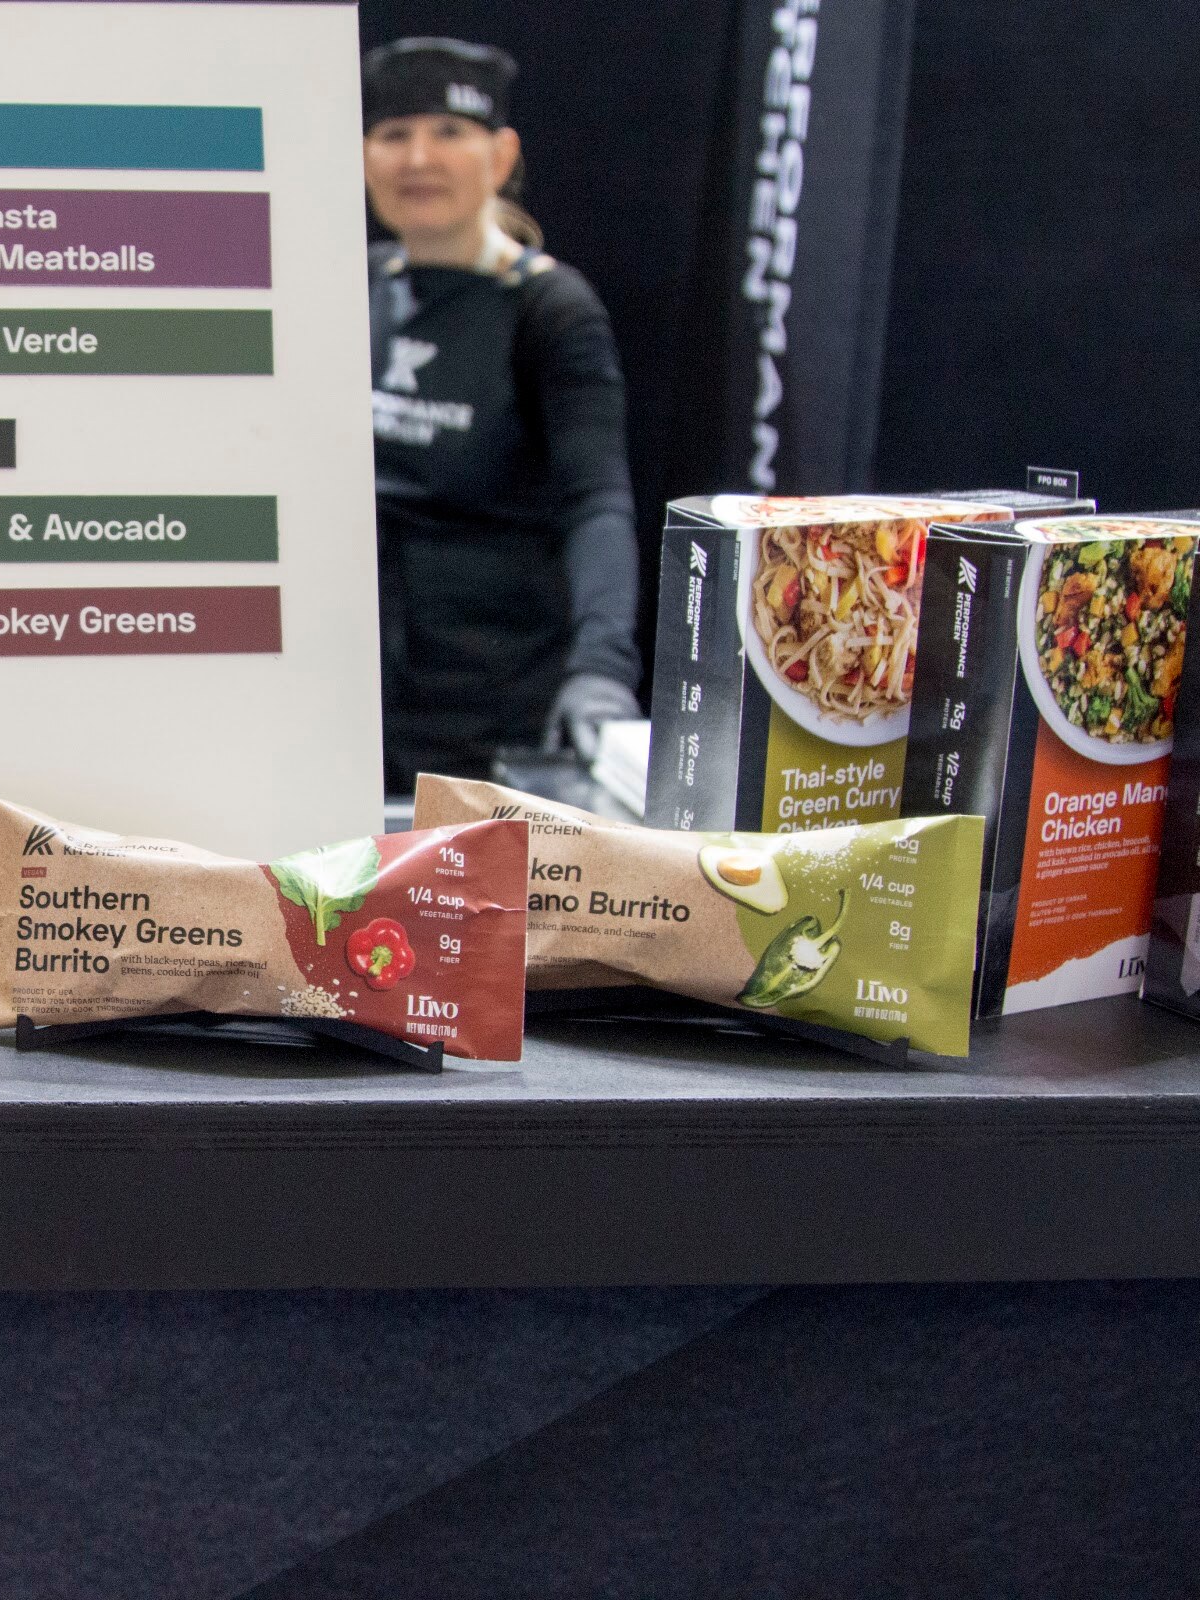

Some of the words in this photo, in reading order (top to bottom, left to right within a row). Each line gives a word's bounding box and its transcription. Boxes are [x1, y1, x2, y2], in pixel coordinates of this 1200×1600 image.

[2, 327, 99, 355] Verde
[1038, 475, 1052, 486] FPO
[1053, 476, 1068, 487] BOX
[7, 513, 33, 543] &
[43, 513, 187, 543] Avocado
[686, 576, 696, 624] KITCHEN
[79, 606, 196, 636] Greens
[691, 577, 703, 661] PERFORMANCE
[953, 592, 964, 640] KITCHEN
[957, 593, 972, 678] PERFORMANCE
[688, 683, 702, 713] 15g
[950, 701, 966, 730] 13g
[688, 733, 700, 758] 1/2
[685, 759, 695, 787] cup
[781, 759, 885, 791] Thai-style
[947, 751, 960, 777] 1/2
[779, 792, 840, 819] Green
[846, 786, 901, 810] Curry
[942, 777, 954, 806] cup
[1044, 789, 1117, 816] Orange
[1122, 781, 1168, 808] Man
[1041, 815, 1122, 843] Chicken
[439, 847, 465, 867] 11g
[435, 867, 465, 877] PROTEIN
[858, 872, 884, 891] 1/4
[888, 881, 915, 897] cup
[19, 884, 150, 911] Southern
[407, 886, 433, 905] 1/4
[437, 893, 465, 909] cup
[589, 890, 690, 922] Burrito
[419, 910, 464, 920] VEGETABLES
[16, 916, 127, 948] Smokey
[136, 918, 243, 947] Greens
[439, 934, 461, 954] 9g
[561, 924, 601, 935] avocado,
[604, 927, 622, 936] and
[624, 929, 657, 939] cheese
[889, 921, 911, 941] 8g
[15, 947, 110, 973] Burrito
[120, 955, 141, 964] with
[144, 955, 195, 967] black-eyed
[198, 957, 222, 969] peas,
[249, 961, 267, 970] and
[120, 966, 155, 976] greens,
[156, 967, 192, 977] cooked
[193, 968, 204, 977] in
[205, 968, 246, 977] avocado
[247, 970, 259, 979] oil
[439, 956, 460, 964] FIBER
